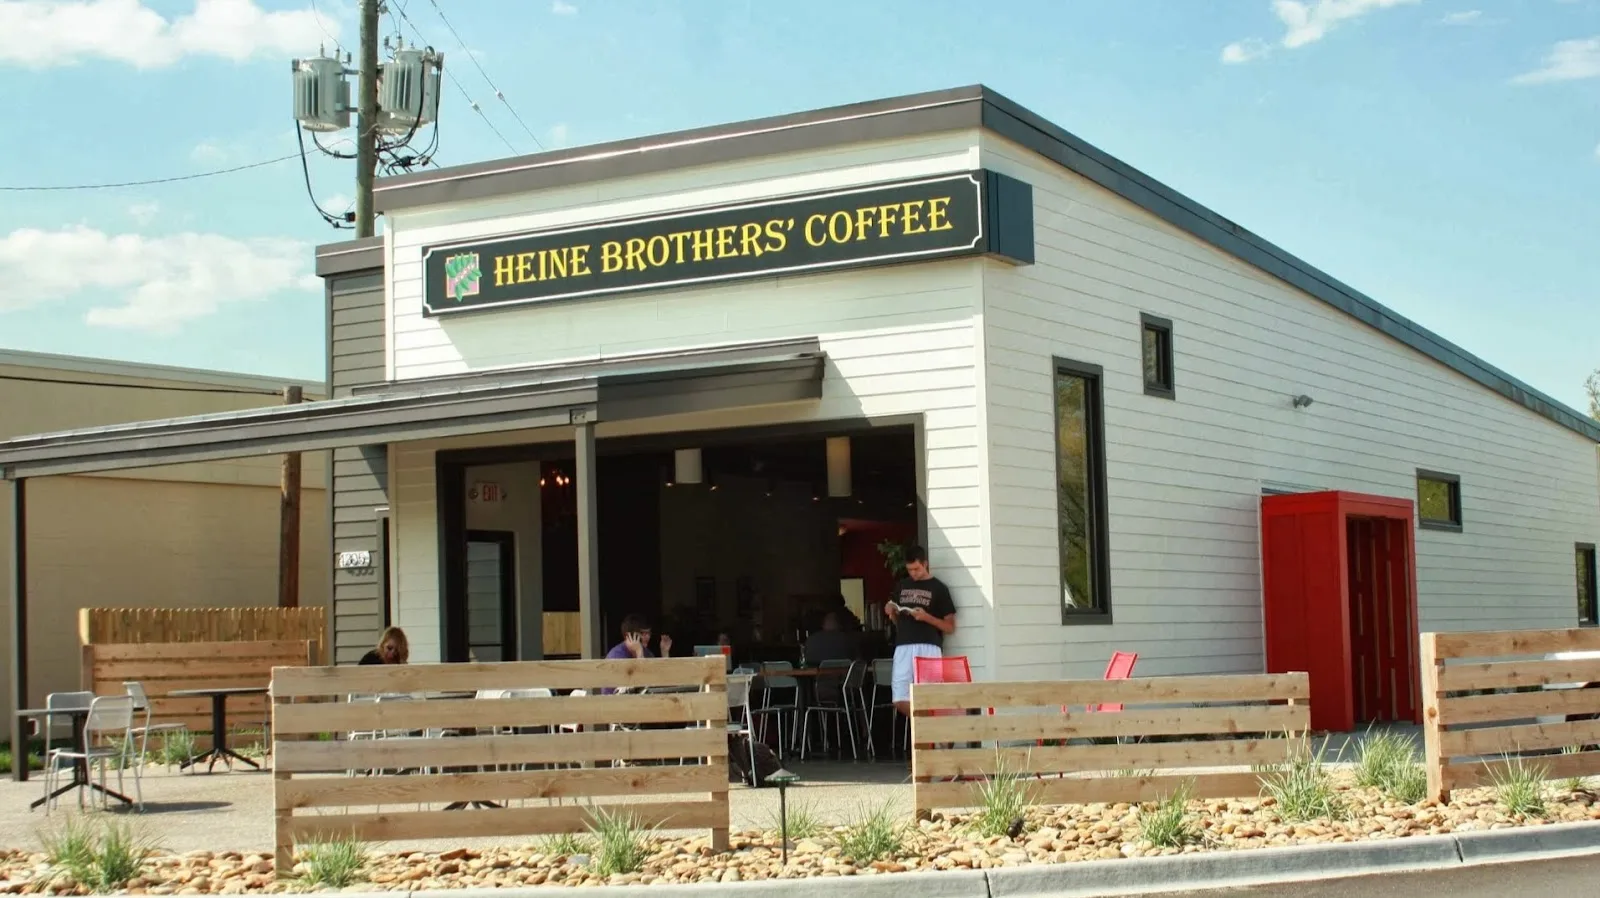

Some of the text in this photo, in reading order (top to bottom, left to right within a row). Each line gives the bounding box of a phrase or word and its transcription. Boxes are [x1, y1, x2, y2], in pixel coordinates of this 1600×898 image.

[493, 196, 953, 286] HEINE BROTHERS’ COFFEE
